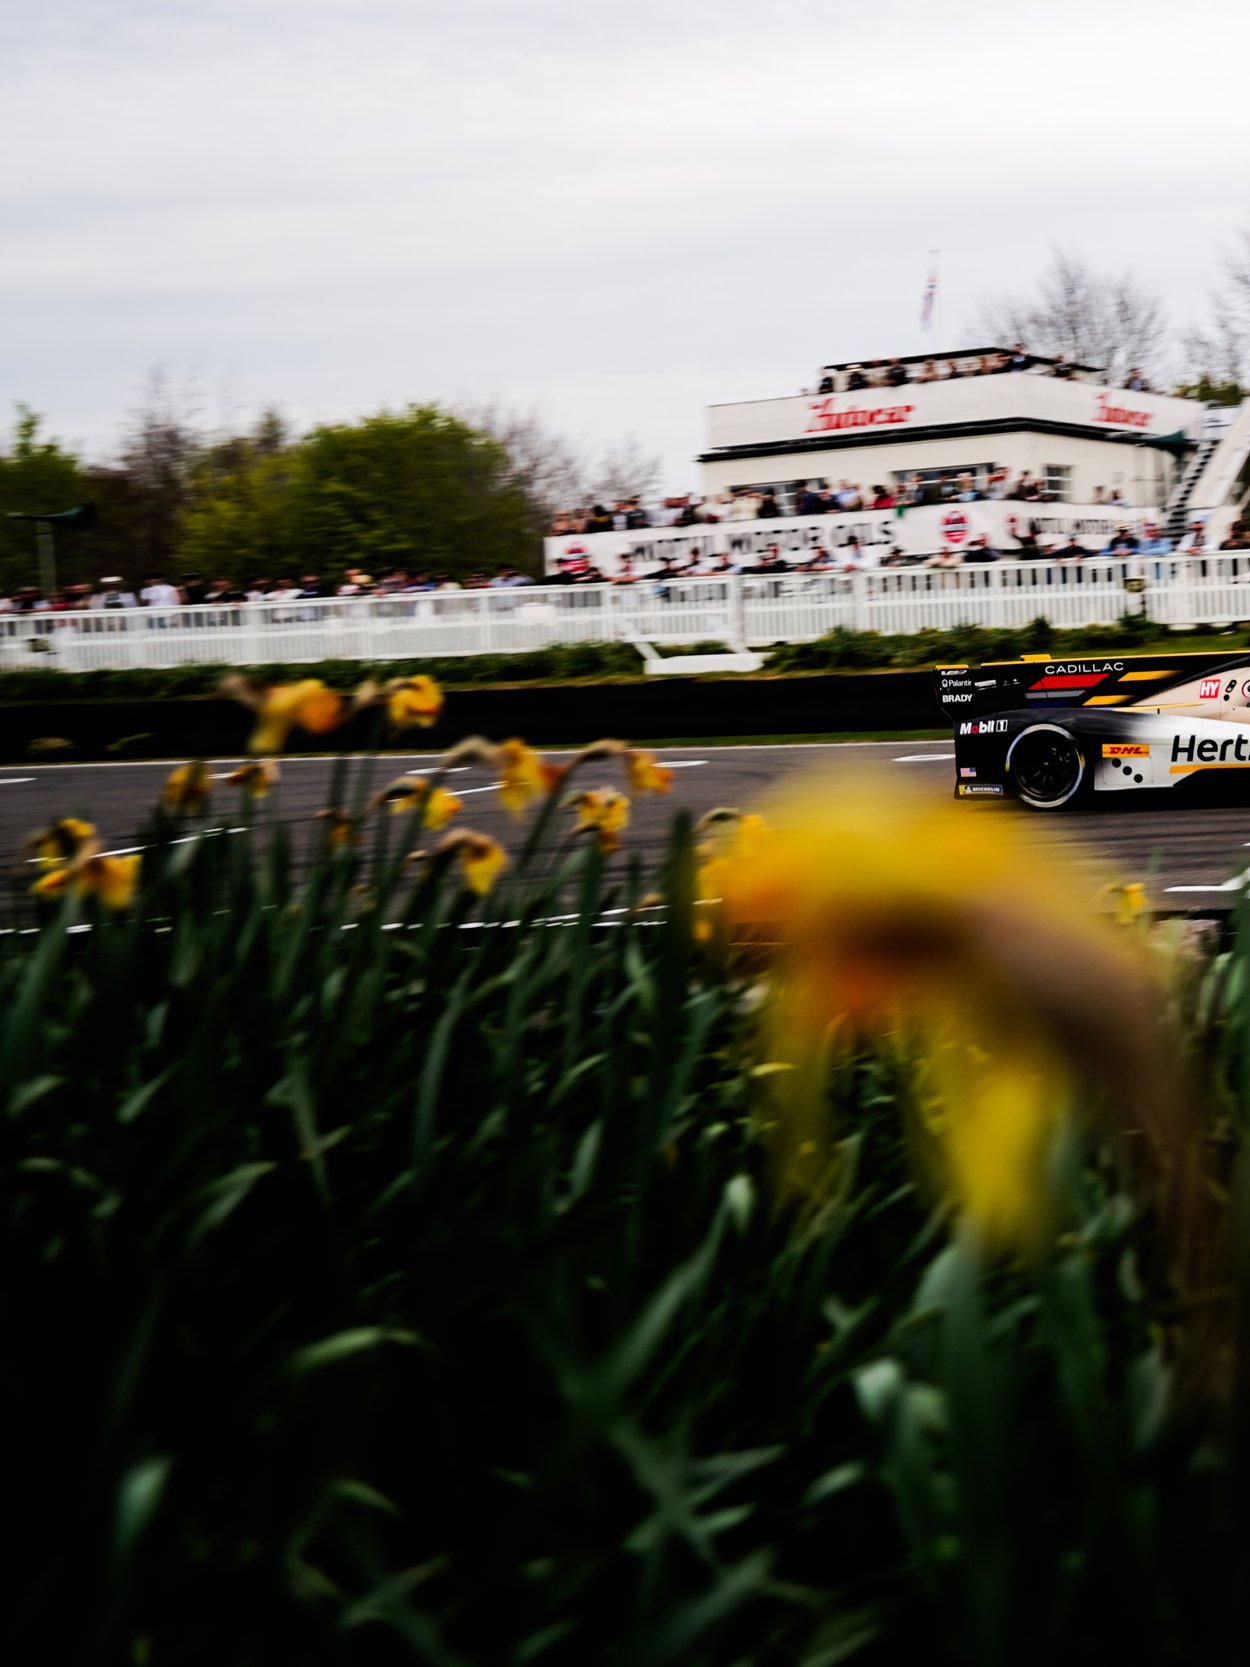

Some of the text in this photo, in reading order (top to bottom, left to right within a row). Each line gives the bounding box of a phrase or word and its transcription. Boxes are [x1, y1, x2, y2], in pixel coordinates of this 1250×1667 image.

[1044, 662, 1124, 675] CADILLAC
[948, 679, 973, 687] Palantir
[1200, 681, 1220, 697] HY
[942, 694, 973, 703] BRADY
[959, 720, 995, 735] Mobil
[1109, 746, 1144, 755] DHL
